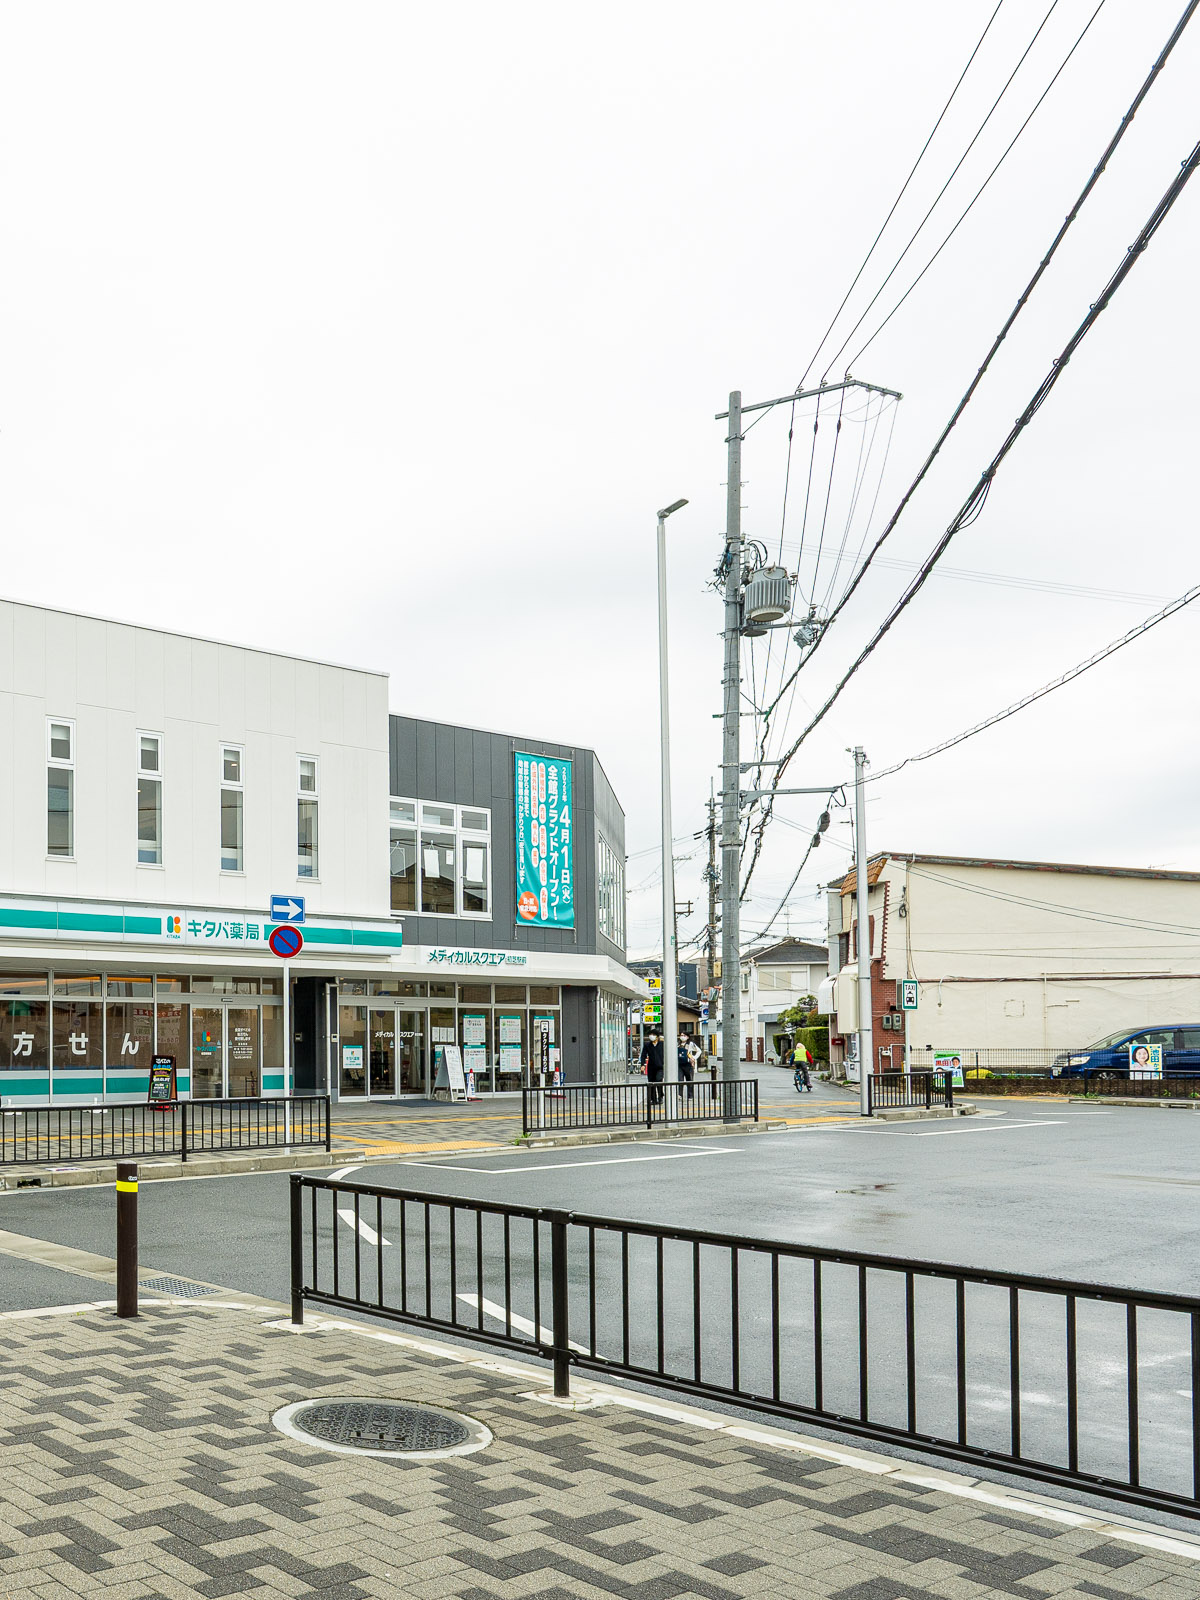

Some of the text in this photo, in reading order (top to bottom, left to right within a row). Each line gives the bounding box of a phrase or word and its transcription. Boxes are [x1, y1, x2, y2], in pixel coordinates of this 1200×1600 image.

[547, 764, 560, 920] 全館グランドオープン!
[188, 919, 260, 941] キタバ薬局
[429, 949, 506, 965] メディカルスクエア
[648, 978, 656, 988] P
